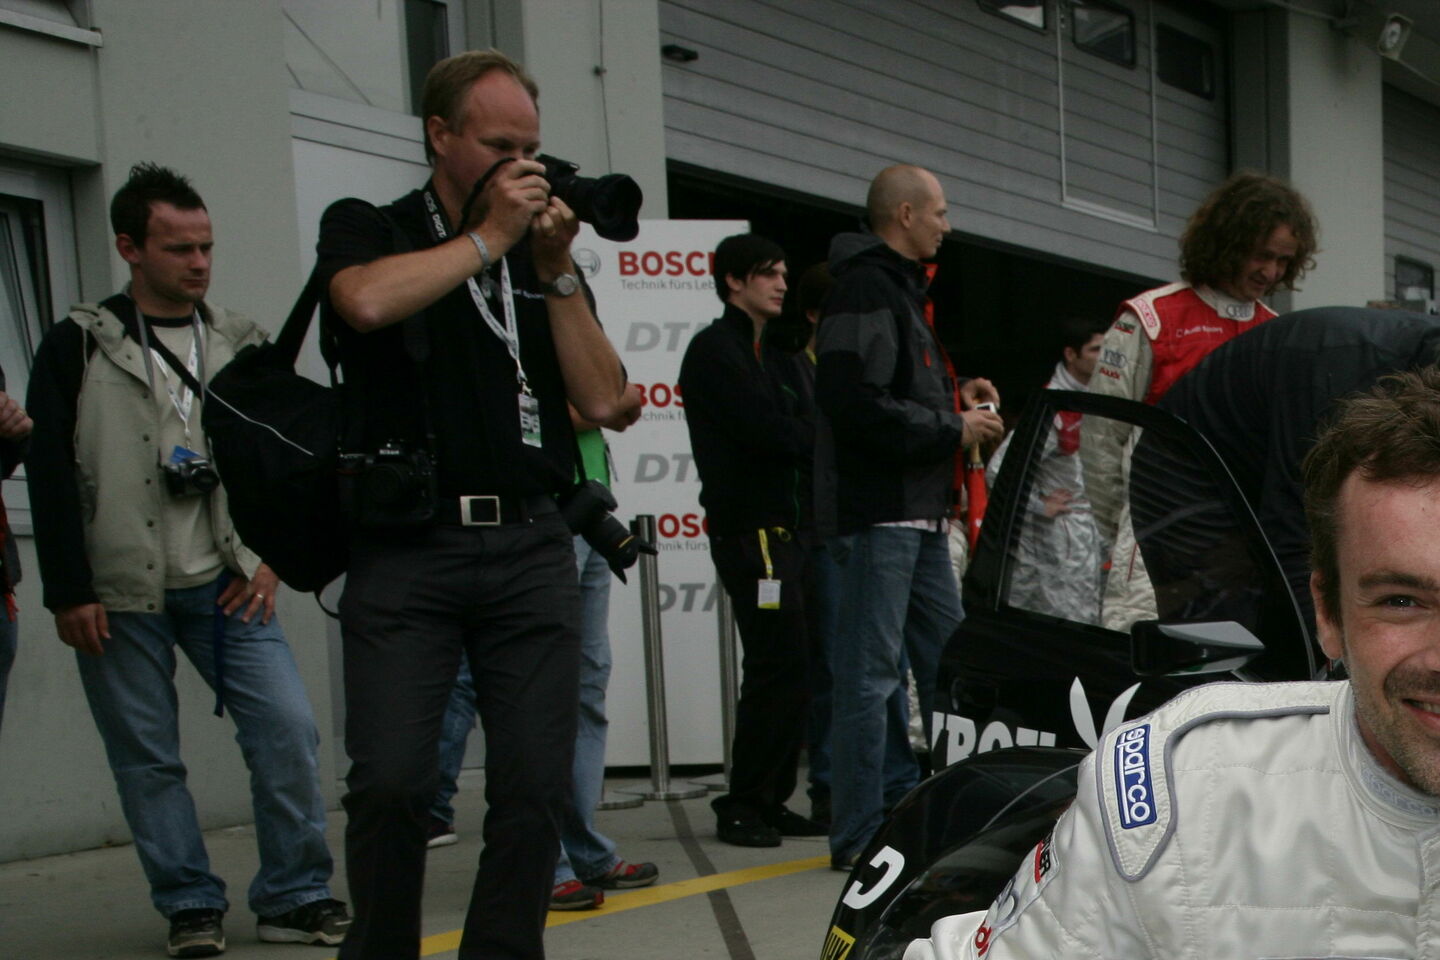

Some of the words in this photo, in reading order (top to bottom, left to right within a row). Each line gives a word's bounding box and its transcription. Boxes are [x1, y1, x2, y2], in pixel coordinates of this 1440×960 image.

[621, 280, 668, 290] Technik
[669, 279, 693, 290] fürs
[696, 279, 716, 290] Leb
[625, 321, 710, 352] DT
[634, 453, 702, 482] DT
[1117, 728, 1151, 822] sparco
